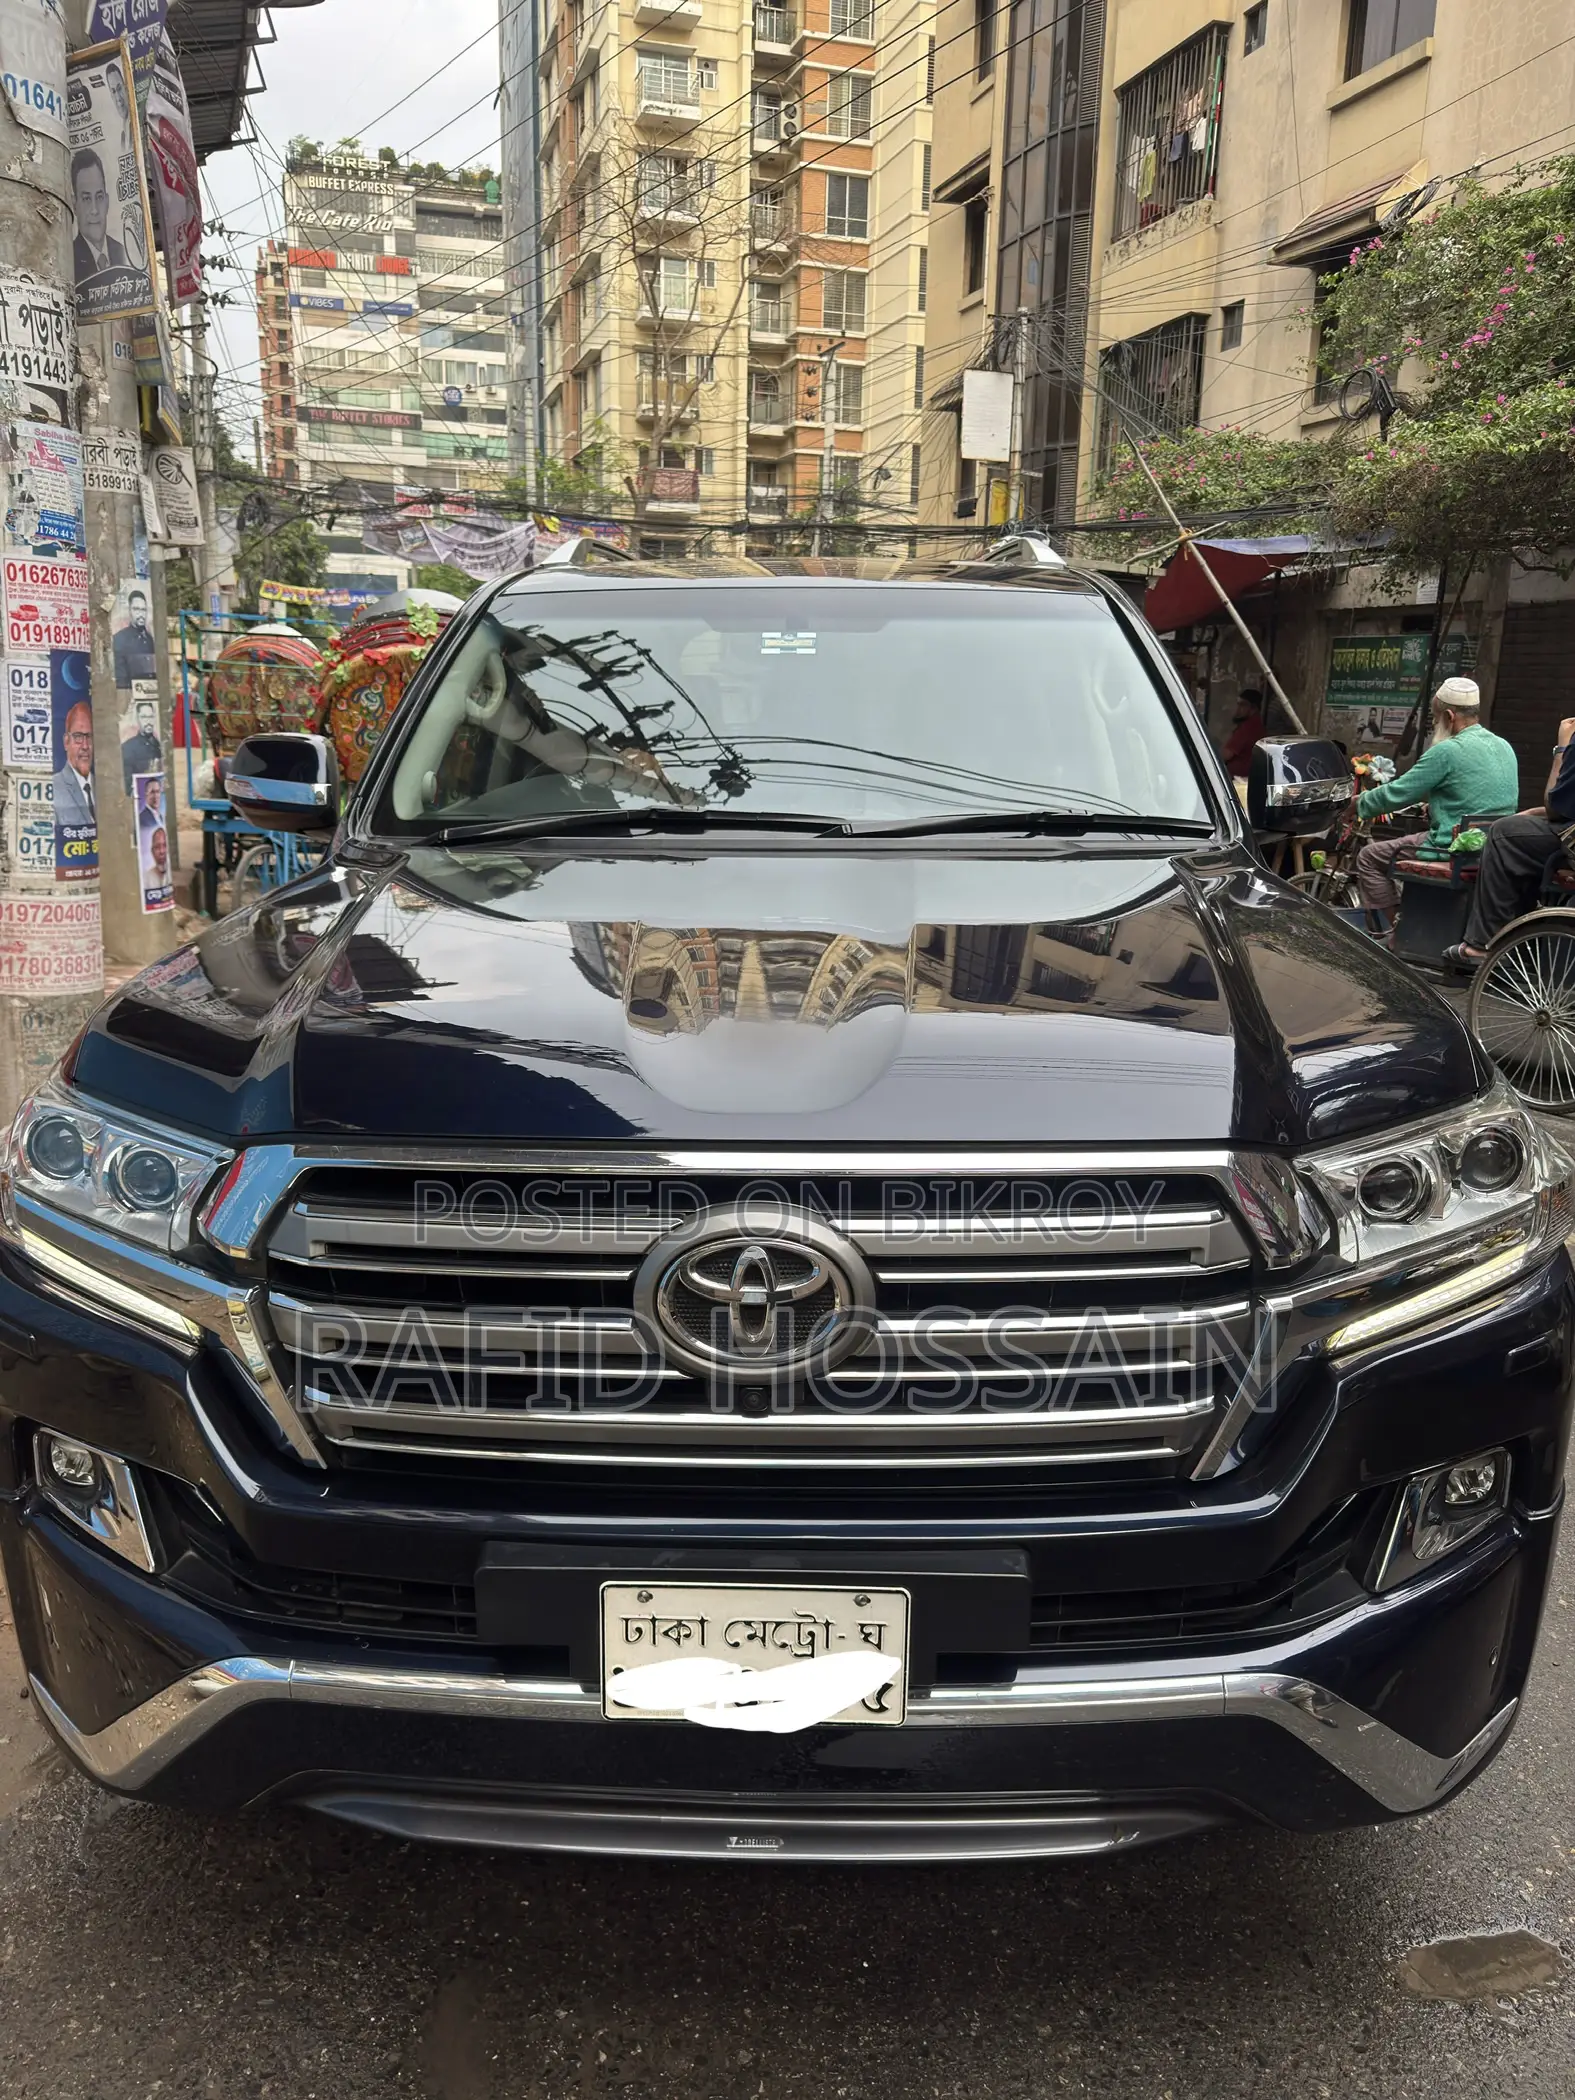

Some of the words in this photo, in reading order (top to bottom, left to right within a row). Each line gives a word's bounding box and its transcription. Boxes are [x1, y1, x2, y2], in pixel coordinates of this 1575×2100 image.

[322, 156, 391, 171] FOREST
[308, 175, 346, 191] BUFFET
[348, 180, 394, 196] EXPRESS
[287, 205, 317, 224] The
[319, 209, 361, 229] Cafe
[337, 252, 374, 272] INFINITY
[308, 298, 335, 309] VIBES
[11, 669, 48, 689] 018
[13, 724, 50, 745] 017
[20, 781, 54, 801] 018
[19, 837, 55, 855] 017
[618, 1612, 712, 1647] ঢাকা
